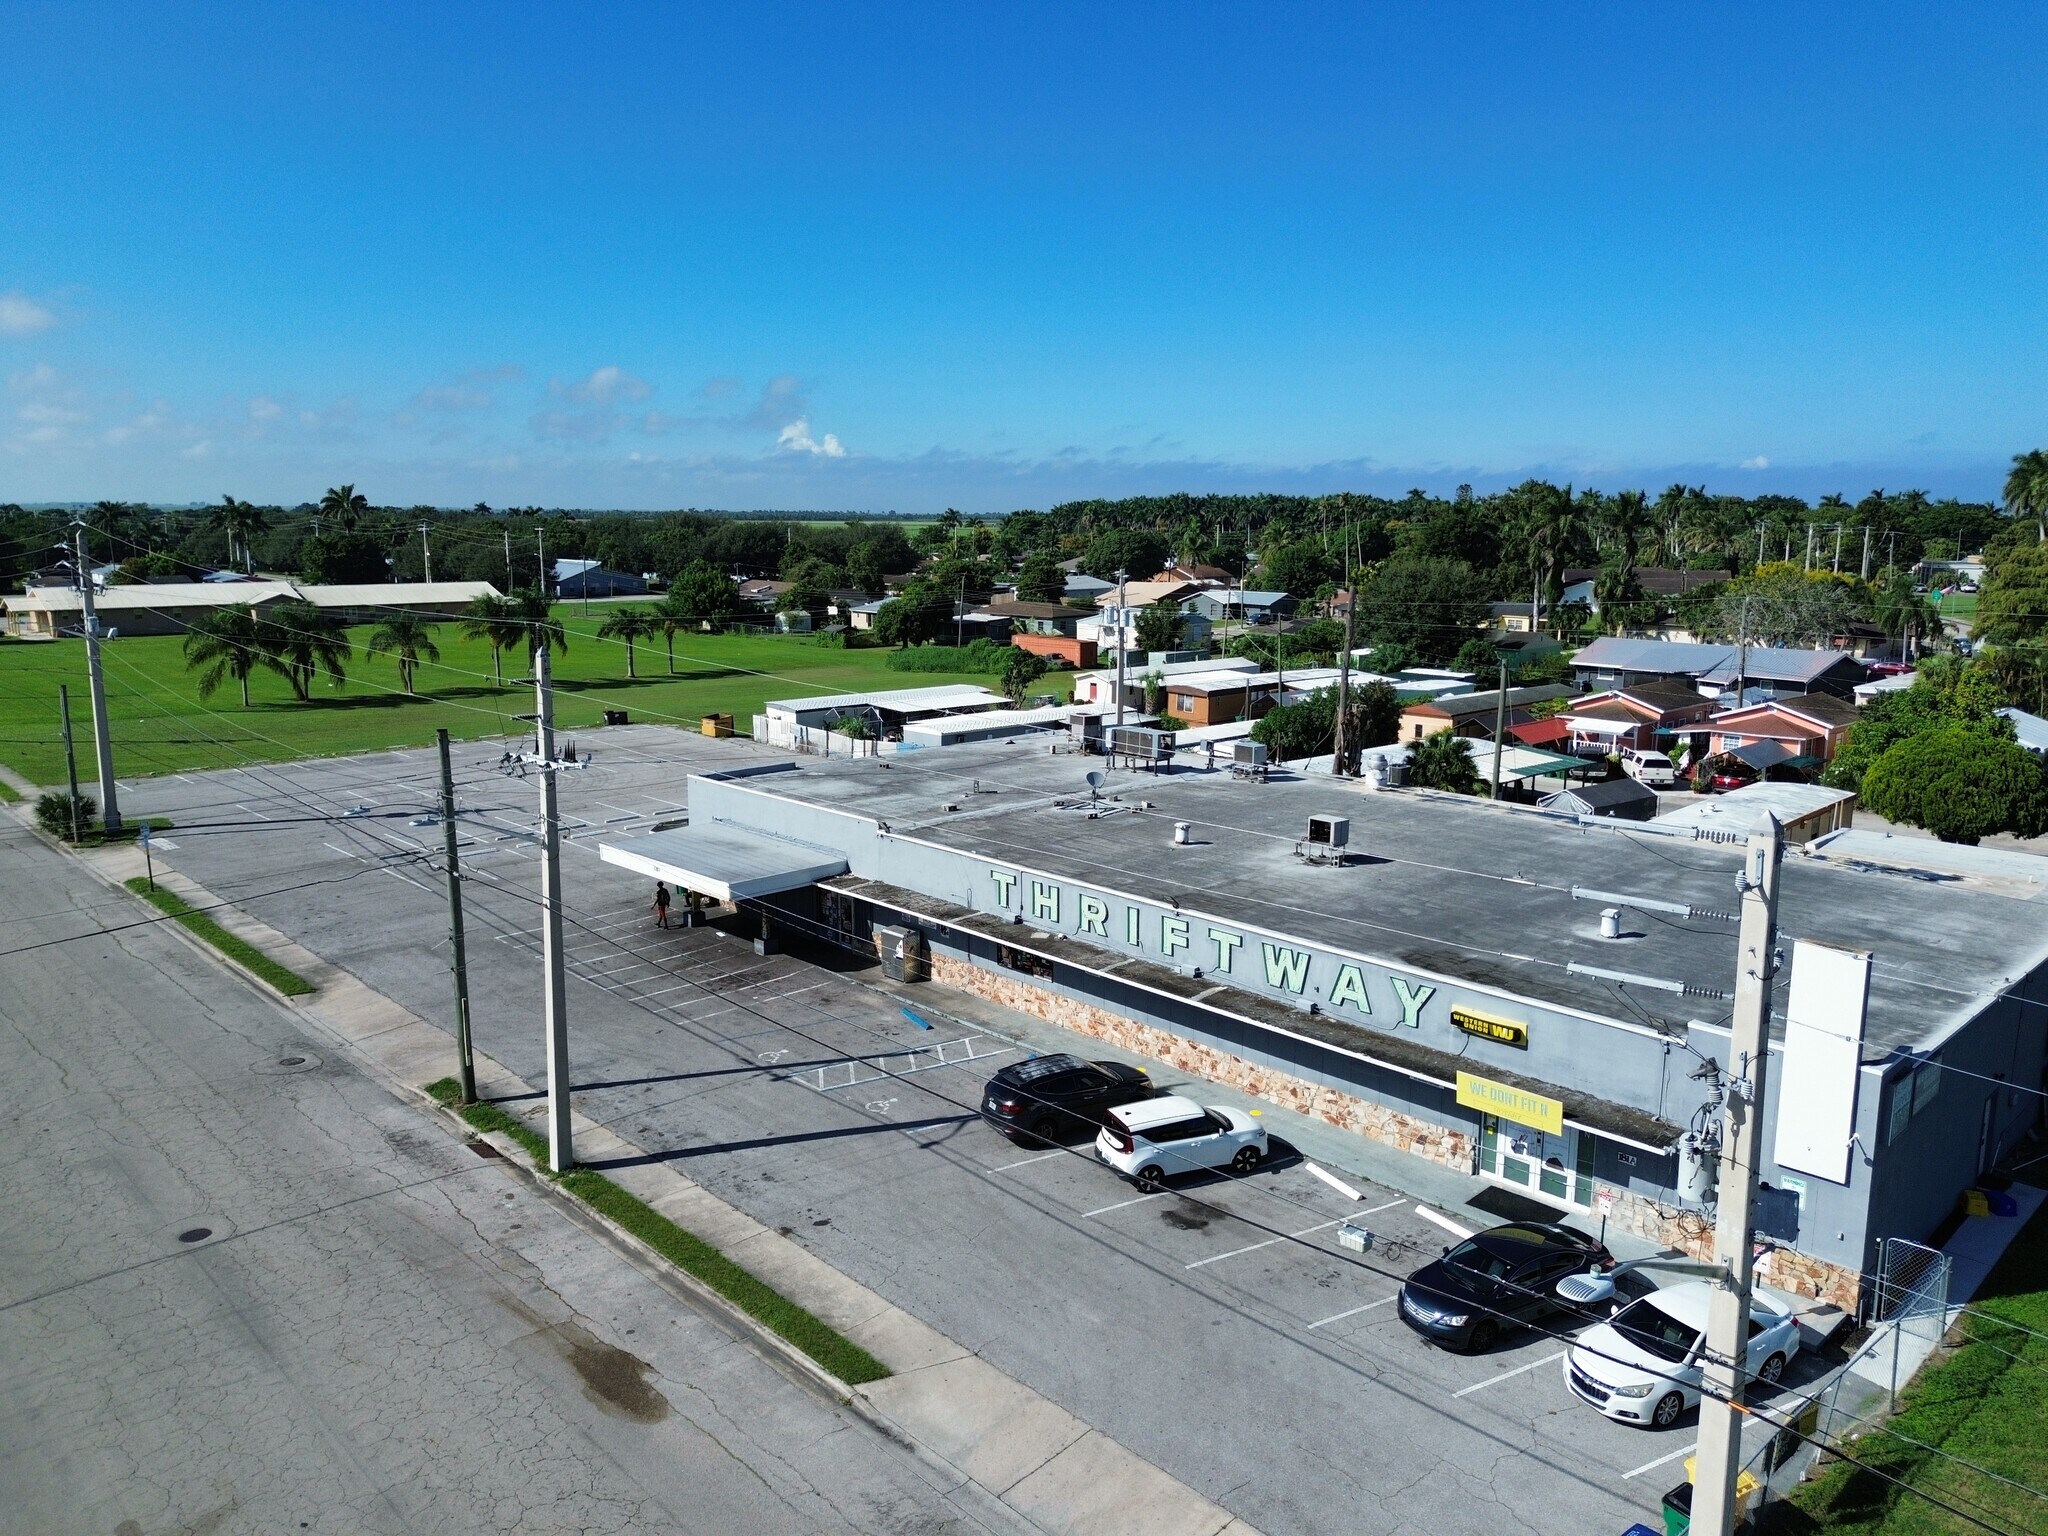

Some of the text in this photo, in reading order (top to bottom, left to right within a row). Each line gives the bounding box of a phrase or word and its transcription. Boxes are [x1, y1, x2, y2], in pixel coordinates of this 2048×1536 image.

[990, 869, 1437, 1029] THRIFTWAY
[1453, 1013, 1489, 1028] WESTERN
[1463, 1022, 1489, 1034] UNION
[1492, 1024, 1514, 1041] WU
[1469, 1081, 1488, 1097] WE
[1521, 1096, 1538, 1114] FIT
